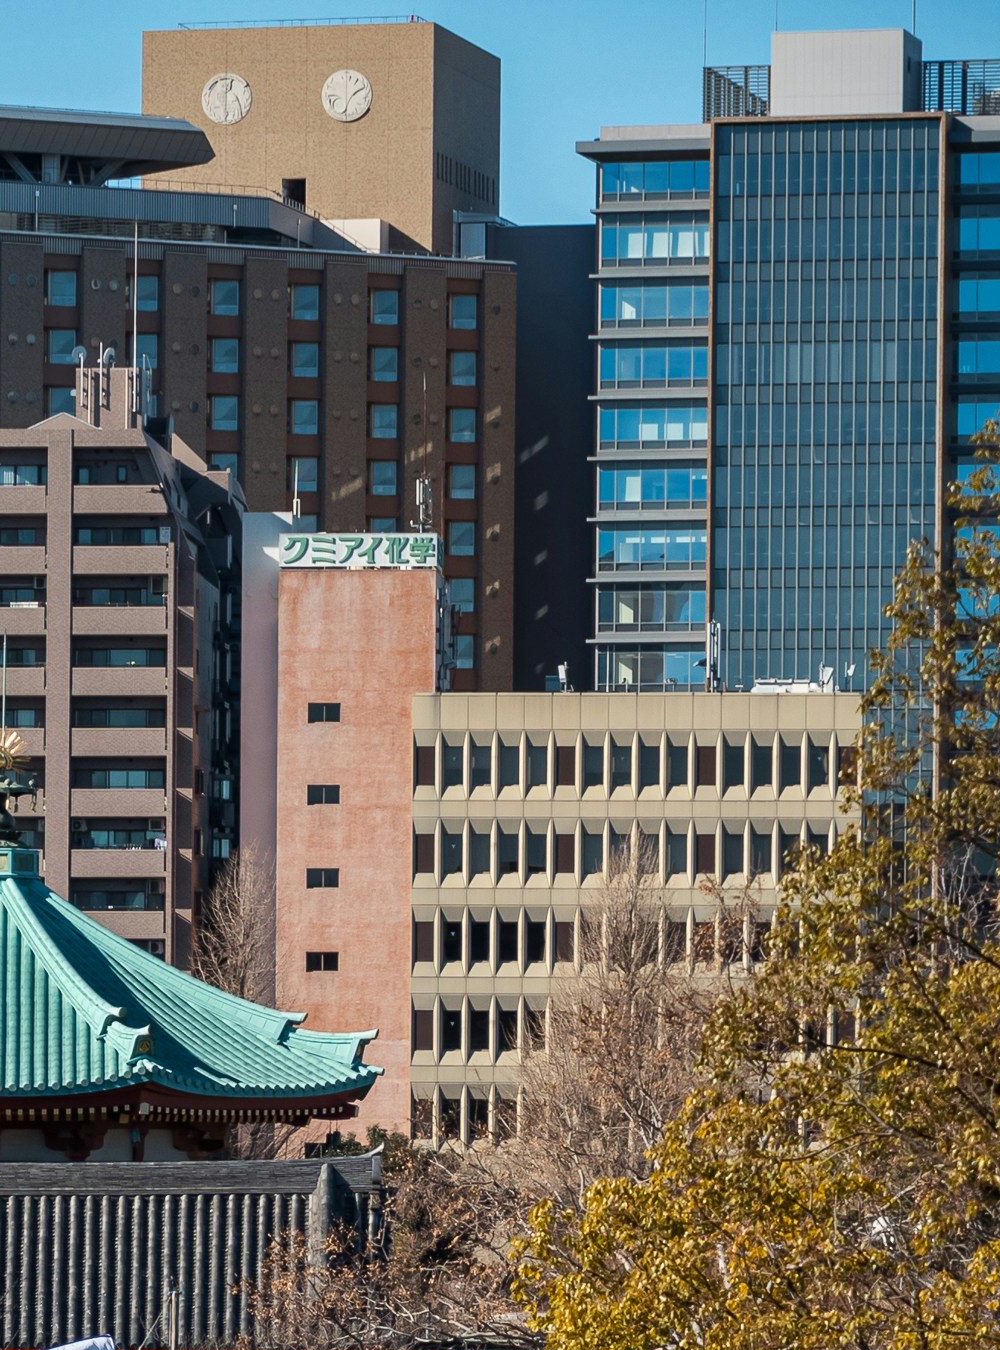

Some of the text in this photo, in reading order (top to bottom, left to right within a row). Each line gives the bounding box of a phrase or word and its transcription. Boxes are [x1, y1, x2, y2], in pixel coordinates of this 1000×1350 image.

[283, 536, 436, 564] クミアイ化学
